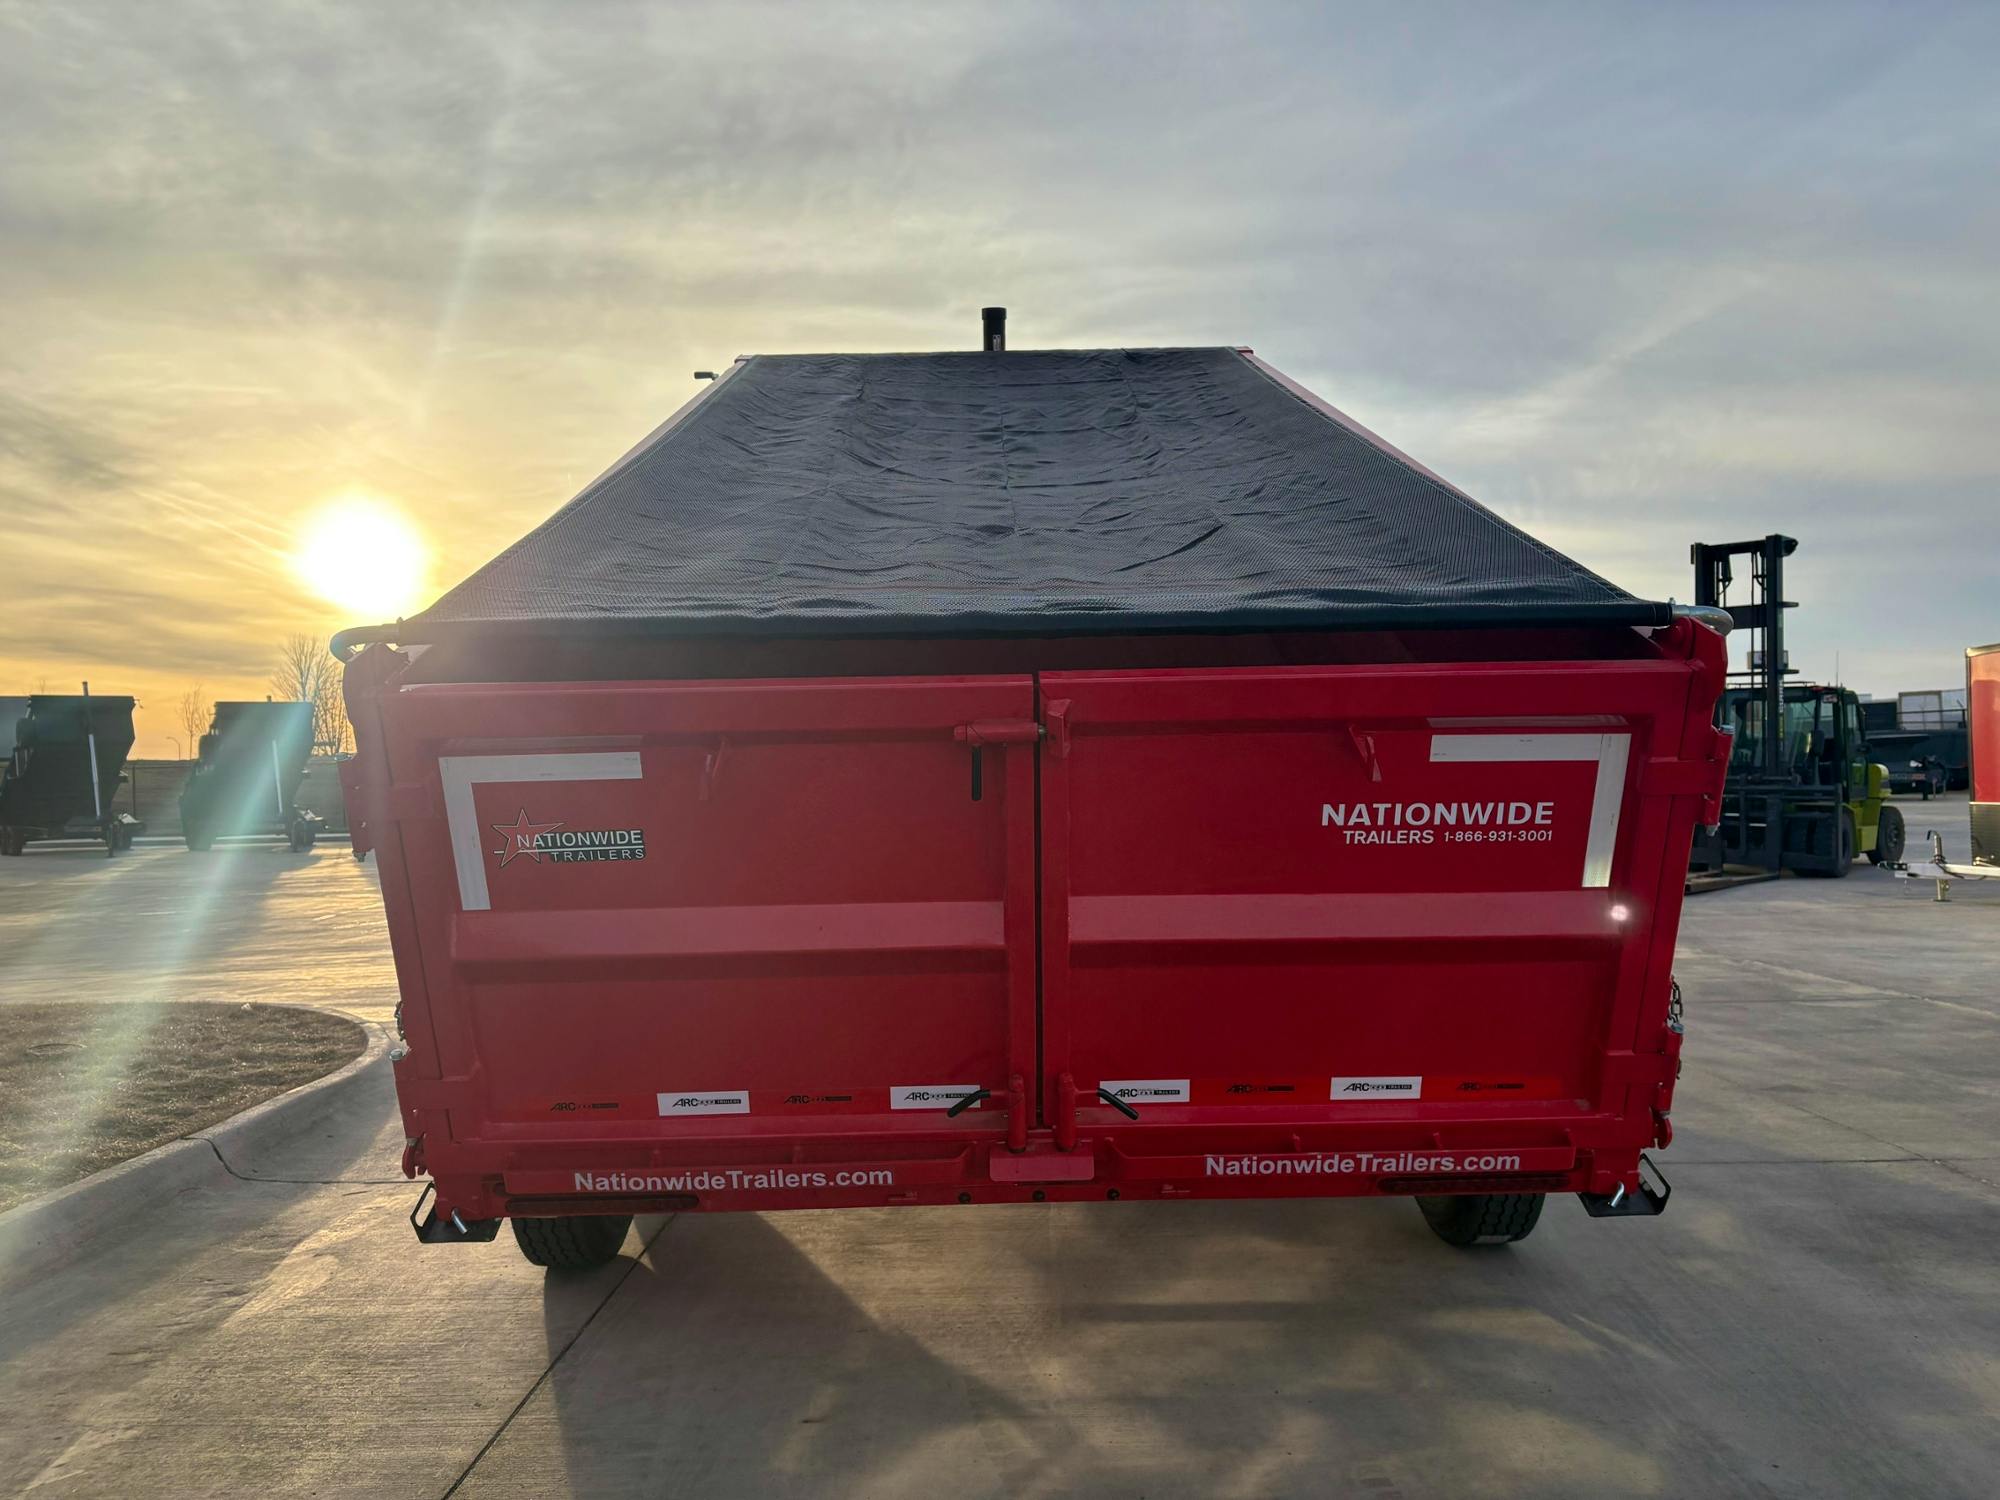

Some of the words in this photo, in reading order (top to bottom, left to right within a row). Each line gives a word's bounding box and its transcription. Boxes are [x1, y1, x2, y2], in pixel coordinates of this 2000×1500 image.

[1321, 802, 1554, 826] NATIONWIDE
[516, 829, 643, 848] NATIONWIDE
[1343, 830, 1435, 845] TRAILERS
[1443, 830, 1553, 842] 1-866-931-3001
[551, 848, 645, 862] TRAILERS
[1114, 1088, 1138, 1098] ARC
[1343, 1082, 1370, 1092] ARC
[672, 1098, 698, 1107] ARC
[904, 1092, 930, 1101] ARC
[1205, 1153, 1521, 1176] NationwideTrailers.com
[573, 1169, 894, 1191] NationwideTrailers.com
